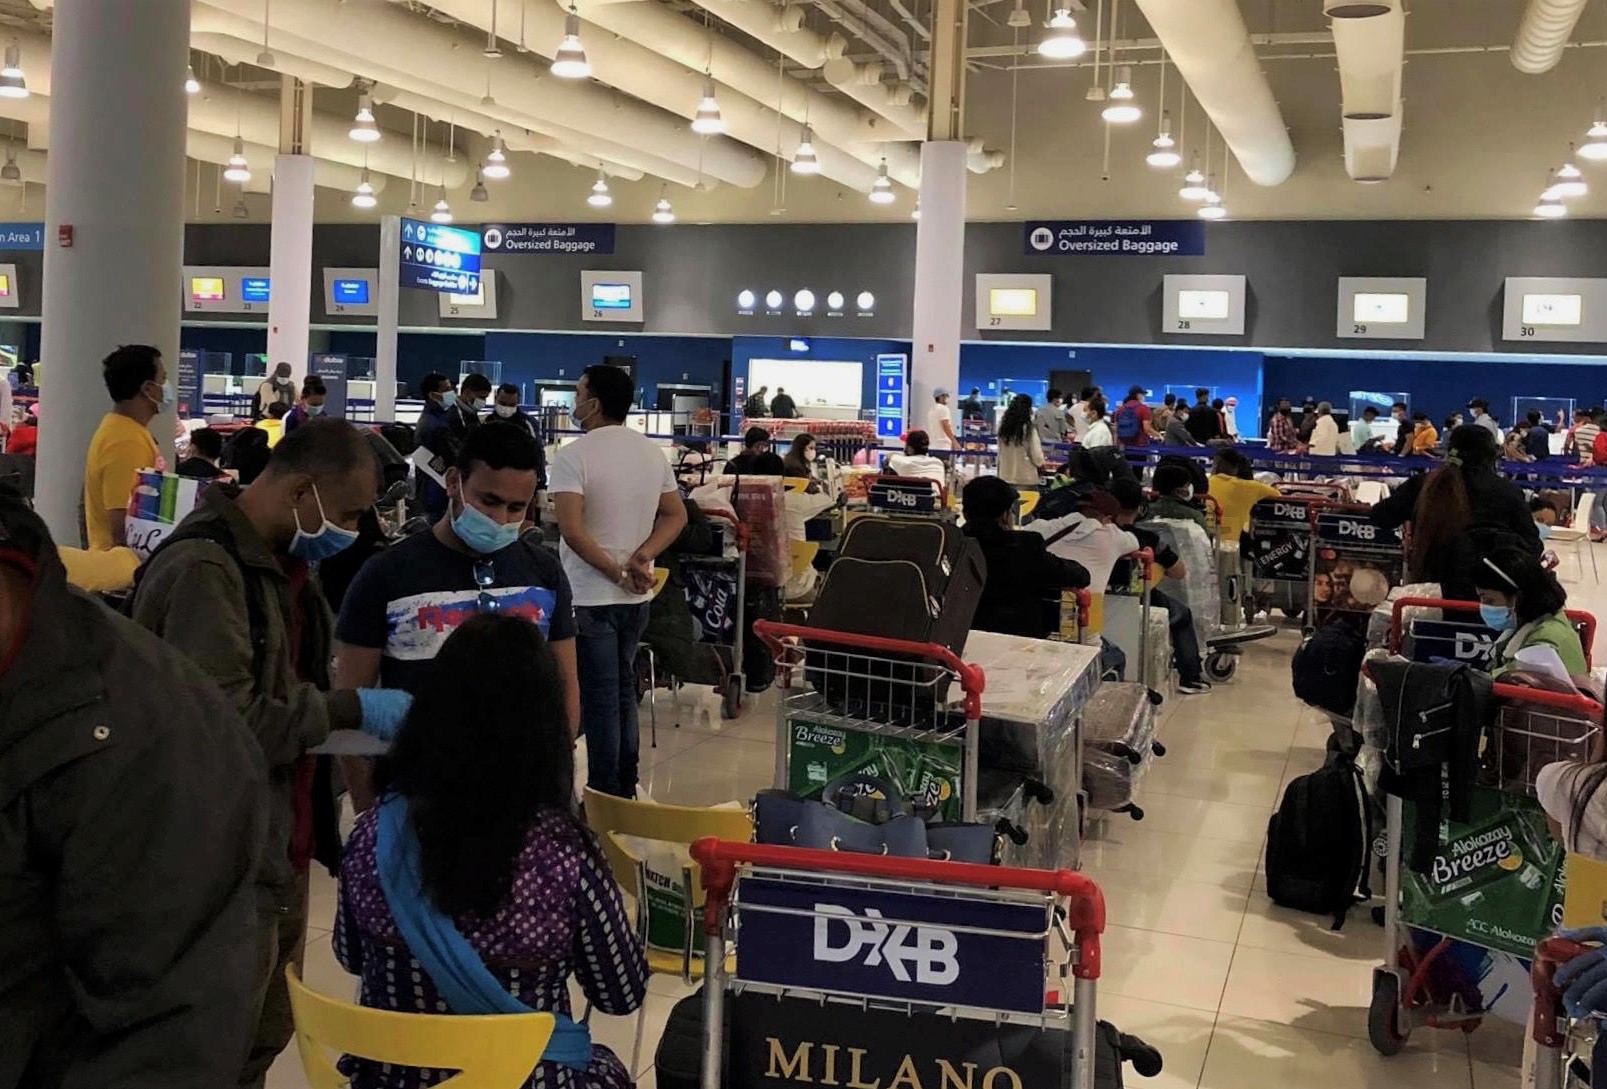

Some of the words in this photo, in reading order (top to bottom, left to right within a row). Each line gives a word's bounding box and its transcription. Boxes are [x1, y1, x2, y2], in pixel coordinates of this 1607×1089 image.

[7, 231, 31, 243] Area
[34, 230, 40, 243] 1
[505, 240, 551, 250] Oversized
[553, 240, 596, 252] Baggage
[1058, 239, 1119, 251] Oversized
[1121, 239, 1179, 253] Baggage
[593, 310, 603, 318] 26
[990, 317, 1001, 326] 27
[1178, 320, 1190, 330] 28
[1353, 325, 1367, 334] 29
[1521, 327, 1535, 337] 30
[887, 489, 917, 507] DXB
[1274, 503, 1307, 520] DXB
[1338, 520, 1376, 540] DXB
[1260, 542, 1294, 566] ENERGY
[795, 725, 842, 746] Breeze
[1451, 824, 1513, 858] Alokozay
[1431, 840, 1511, 884] Breeze
[813, 903, 960, 987] DXB
